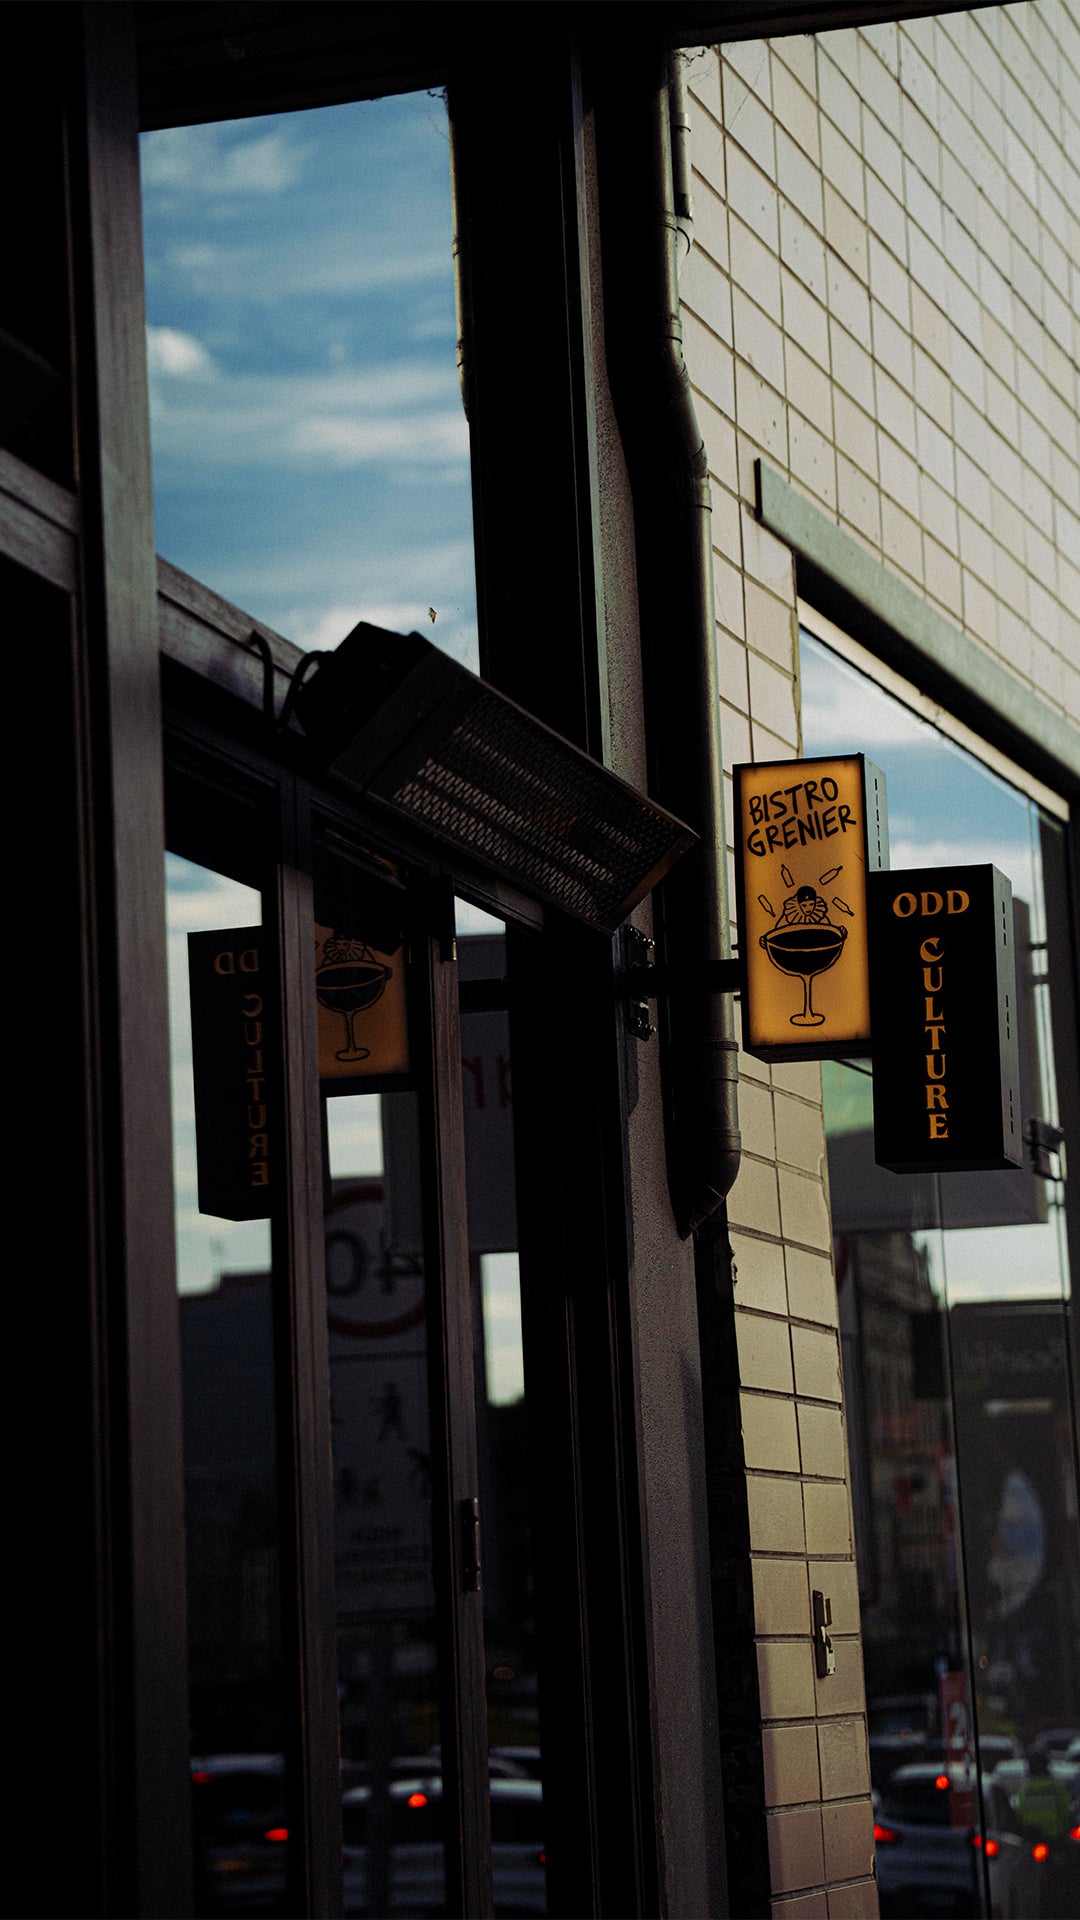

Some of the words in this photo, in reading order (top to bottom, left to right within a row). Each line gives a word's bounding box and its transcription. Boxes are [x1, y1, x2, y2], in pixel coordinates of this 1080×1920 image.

[748, 777, 839, 825] BISTRO
[747, 805, 857, 857] GRENIER
[892, 889, 970, 918] ODD
[919, 936, 950, 1140] CULTURE
